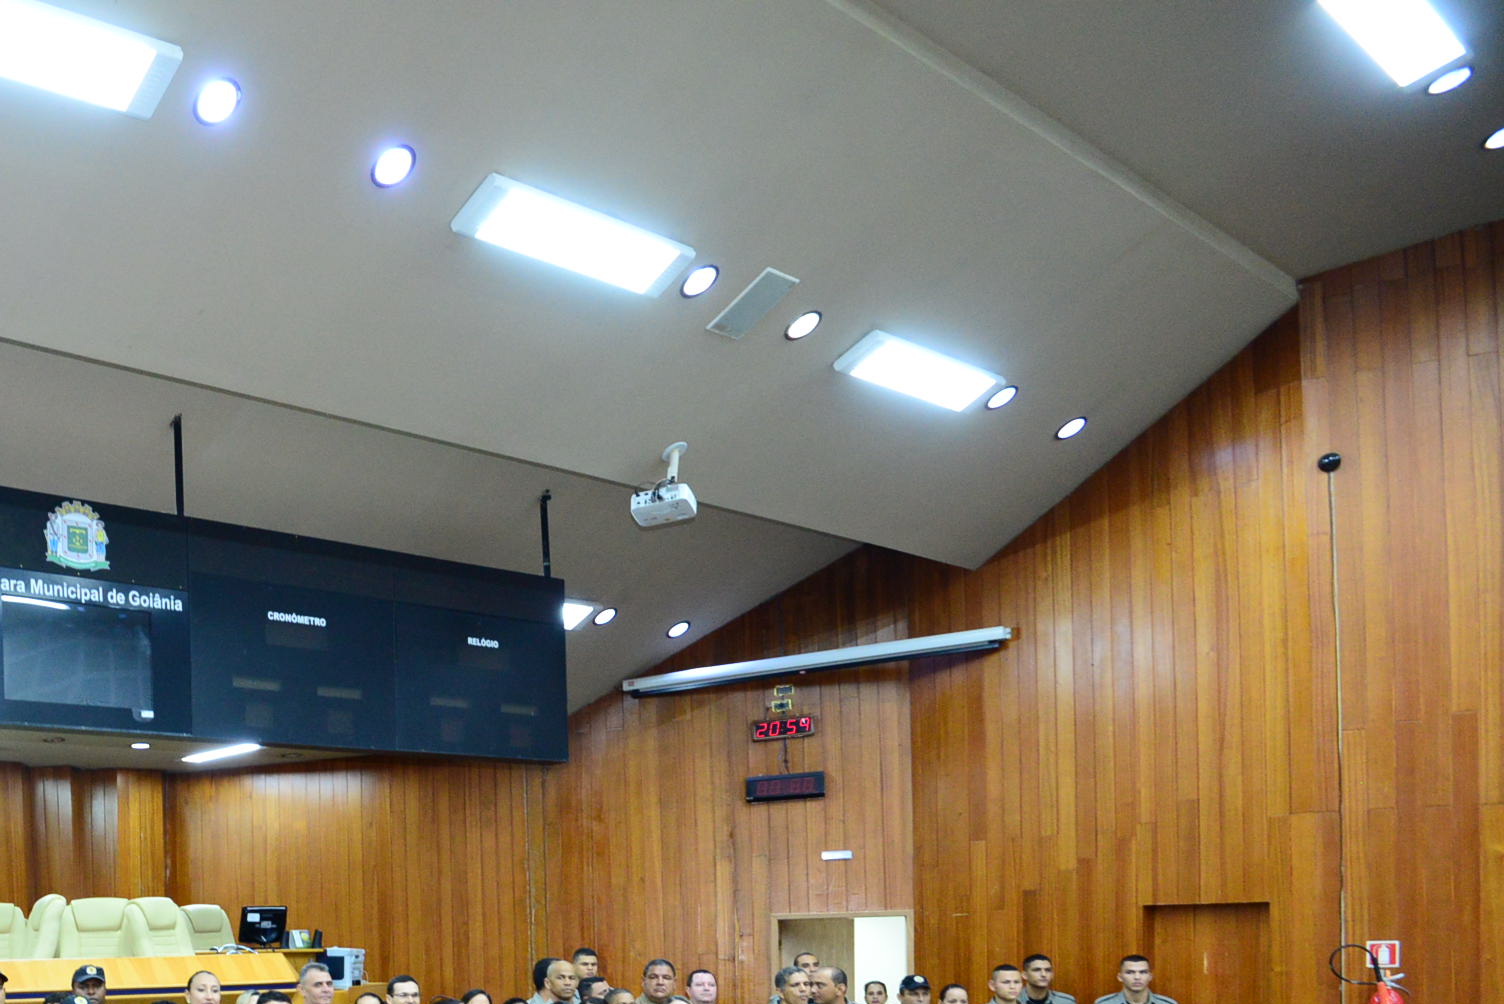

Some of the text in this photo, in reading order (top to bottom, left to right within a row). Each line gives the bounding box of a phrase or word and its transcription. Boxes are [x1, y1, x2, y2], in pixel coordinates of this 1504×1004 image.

[30, 578, 104, 604] Municipal
[108, 588, 125, 605] de
[128, 590, 183, 612] Goiânia
[267, 611, 327, 627] CRONÔMETRO
[467, 636, 499, 649] RELÓGIO
